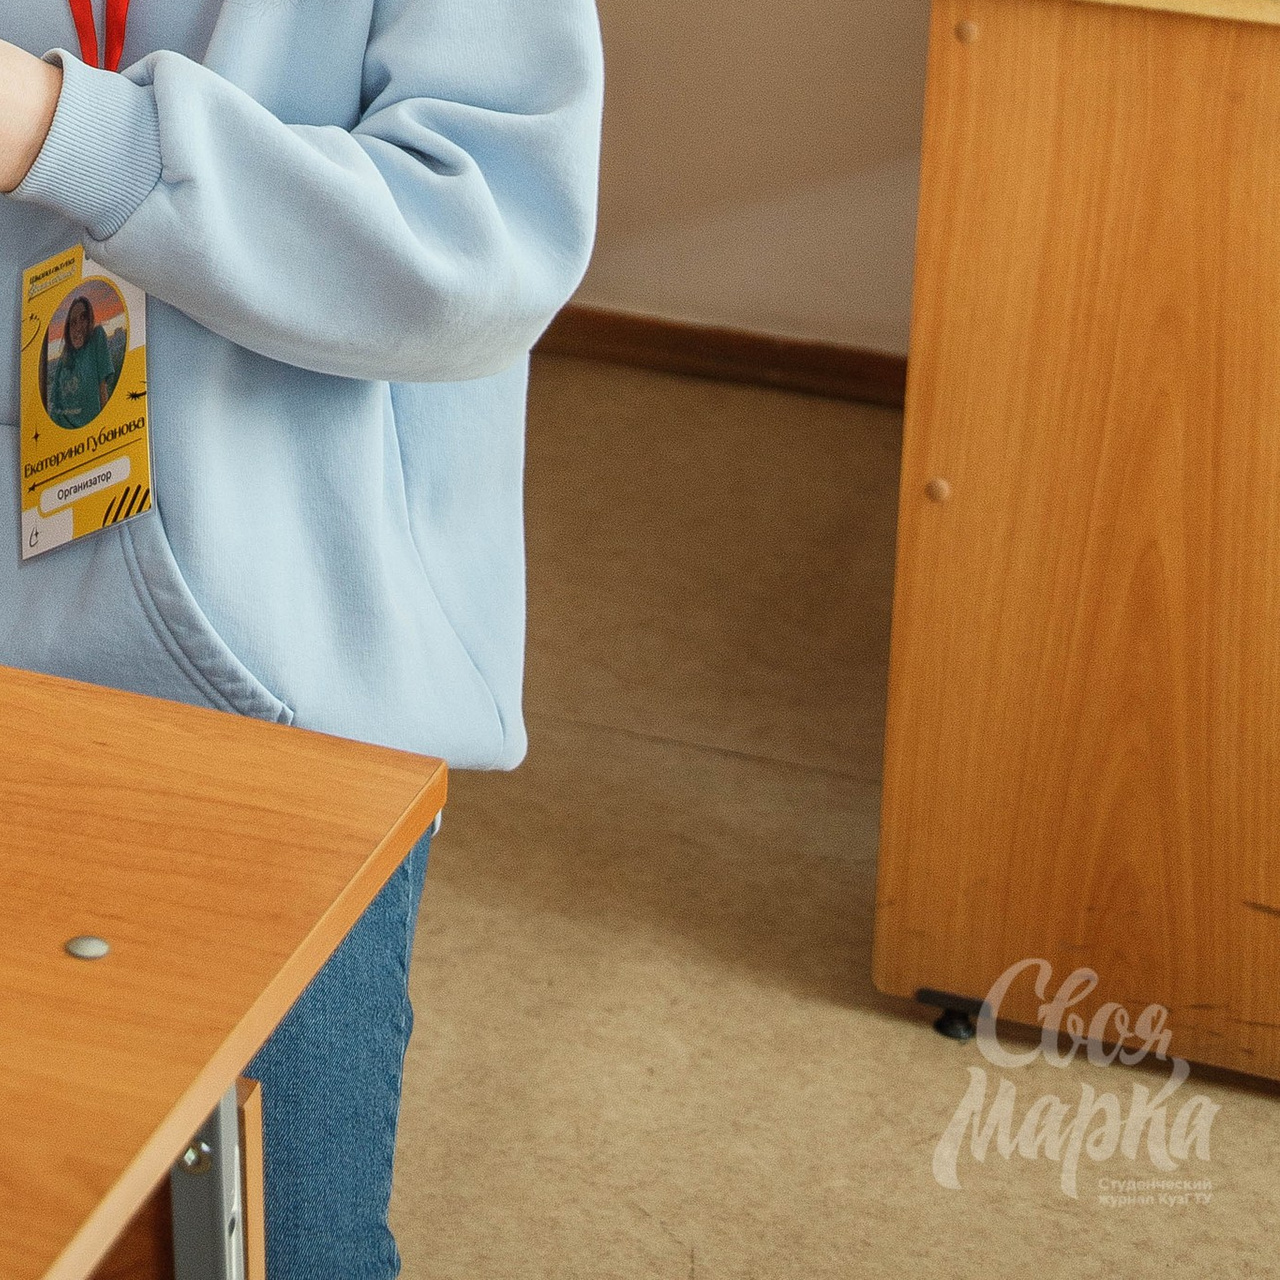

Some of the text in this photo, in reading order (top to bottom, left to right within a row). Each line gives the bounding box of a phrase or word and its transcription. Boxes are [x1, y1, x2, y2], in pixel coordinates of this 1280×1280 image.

[24, 416, 145, 478] Екатерина Губанова
[57, 469, 113, 500] Организатор
